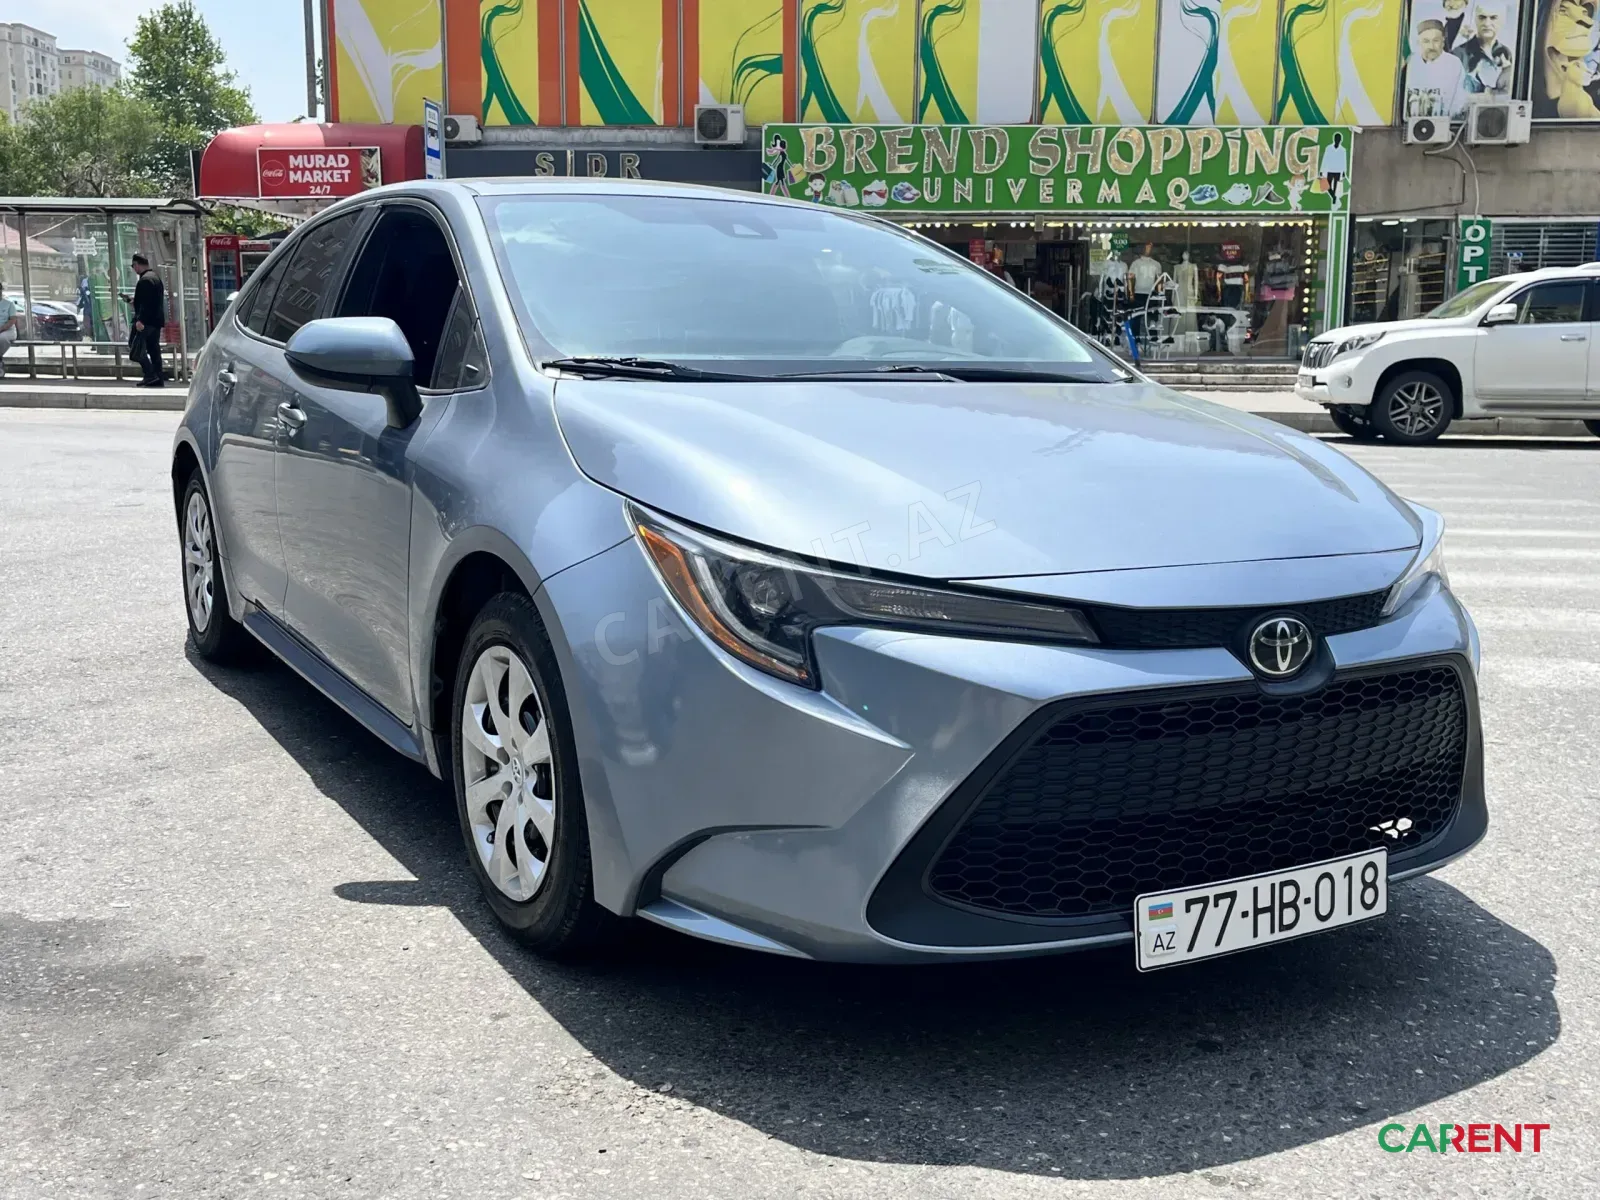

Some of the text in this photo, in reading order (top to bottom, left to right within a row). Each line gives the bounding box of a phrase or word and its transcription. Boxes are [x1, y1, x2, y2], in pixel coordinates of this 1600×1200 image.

[799, 127, 1010, 174] BREND
[289, 154, 350, 168] MURAD
[289, 170, 351, 183] MARKET
[309, 185, 331, 195] 24/7
[923, 177, 1190, 210] UNIVERMAQ
[1185, 861, 1379, 952] 77-HB-018
[1152, 932, 1176, 952] AZ
